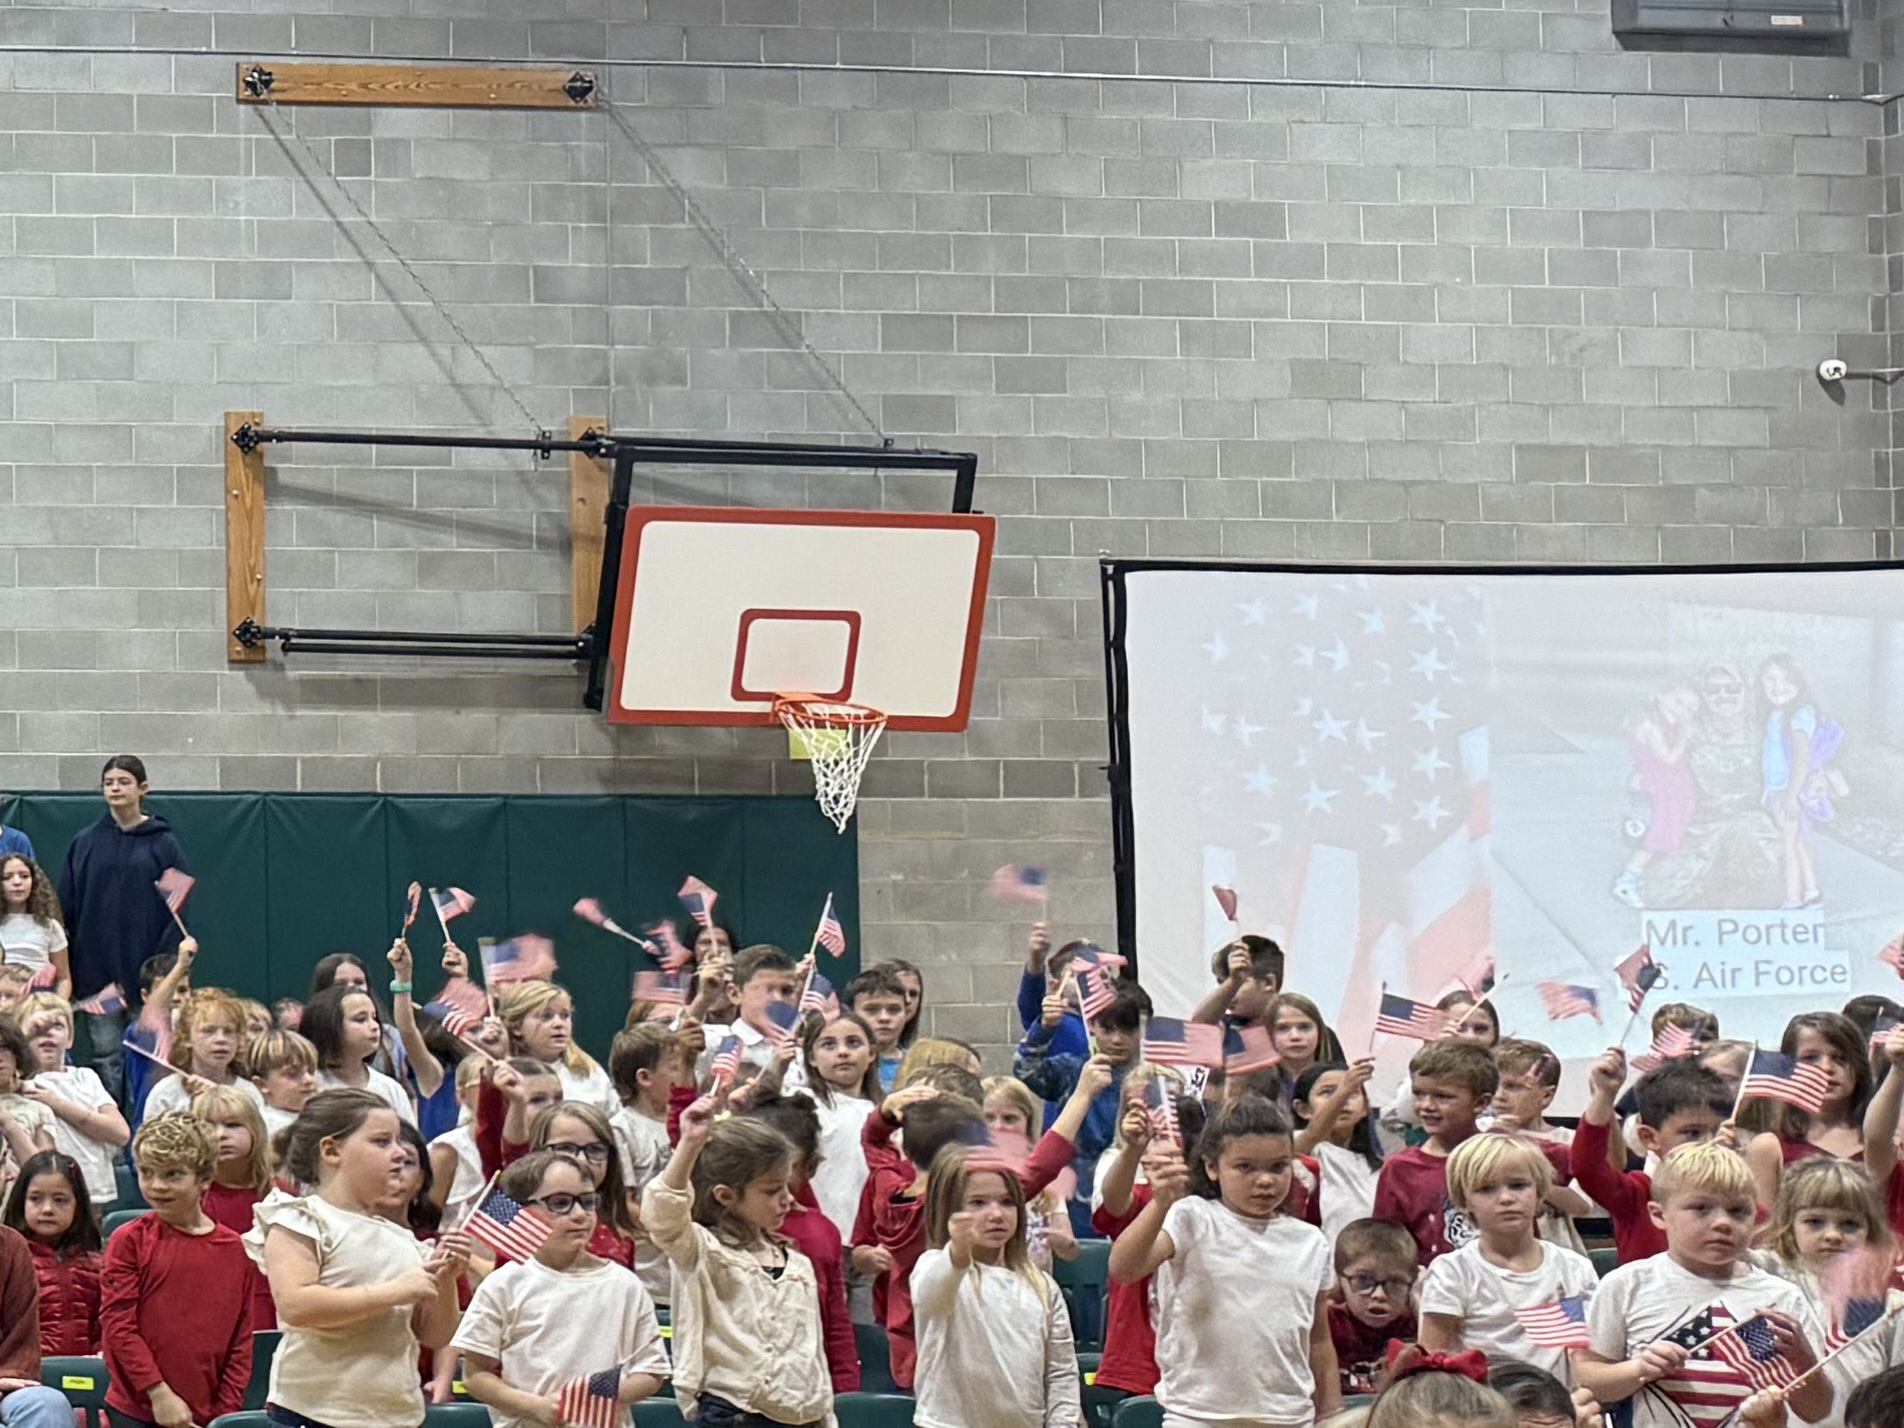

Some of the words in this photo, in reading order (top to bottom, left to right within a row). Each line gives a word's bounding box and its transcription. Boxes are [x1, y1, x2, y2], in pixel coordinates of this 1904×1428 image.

[1645, 919, 1701, 948] Mr.
[1717, 917, 1826, 947] Porter
[1693, 961, 1743, 990] Air
[1754, 958, 1848, 988] Force
